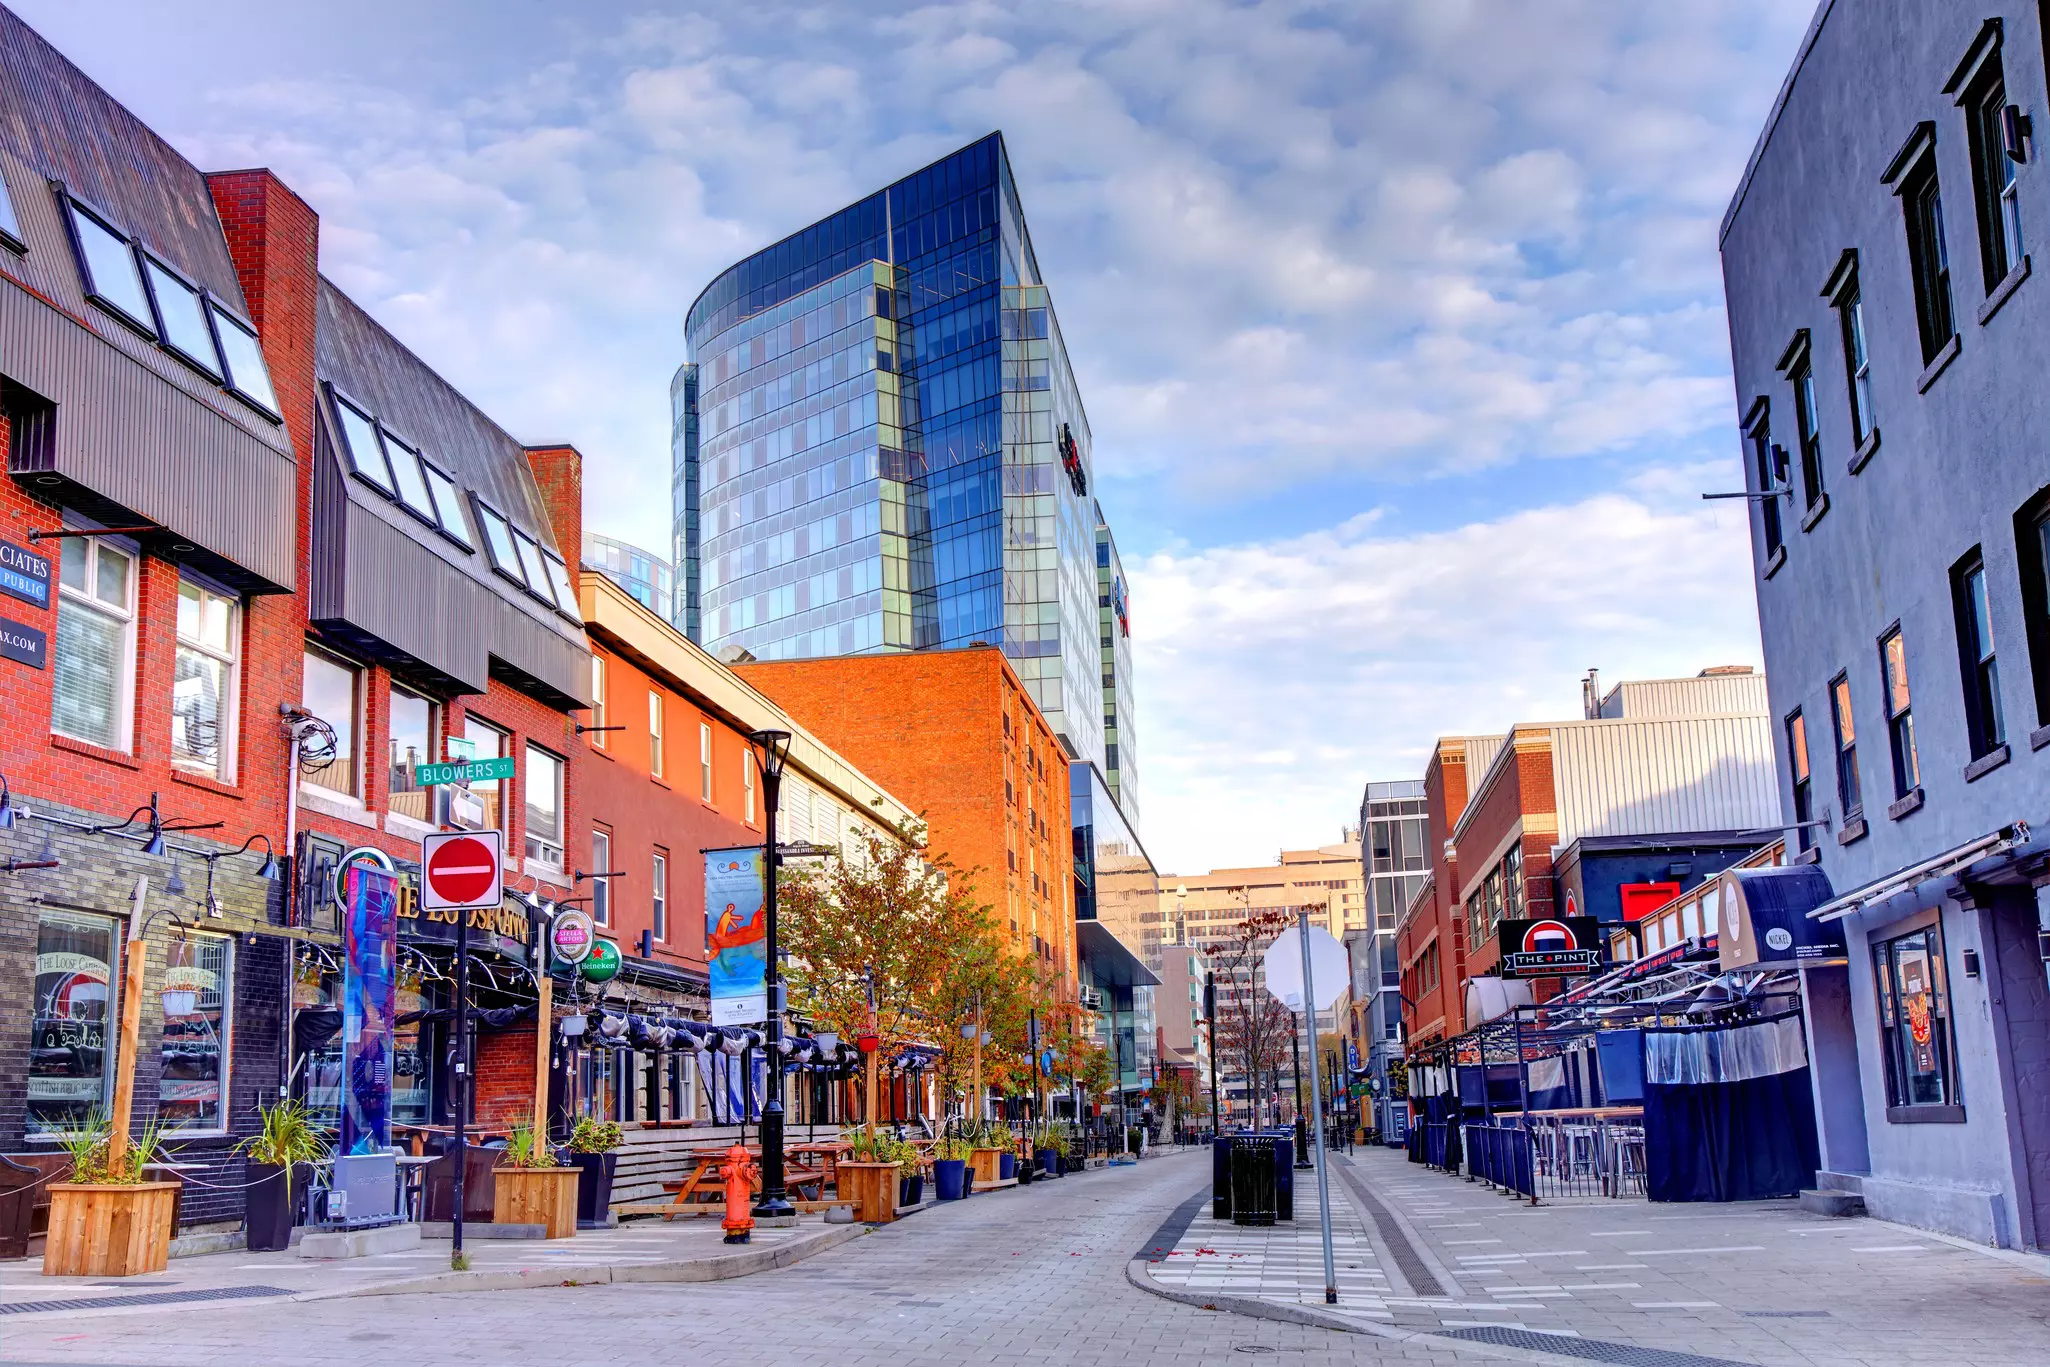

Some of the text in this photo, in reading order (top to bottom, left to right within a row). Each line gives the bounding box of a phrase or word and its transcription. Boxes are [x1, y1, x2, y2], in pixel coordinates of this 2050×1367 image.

[0, 546, 47, 578] CIATES
[4, 572, 43, 597] PUBLIC
[423, 763, 508, 782] BLOWERS ST
[1768, 934, 1790, 945] NICKEL
[37, 956, 53, 971] THE
[1517, 953, 1586, 964] THE PINT
[581, 962, 616, 970] Heineken
[1517, 966, 1551, 974] PUBLIC
